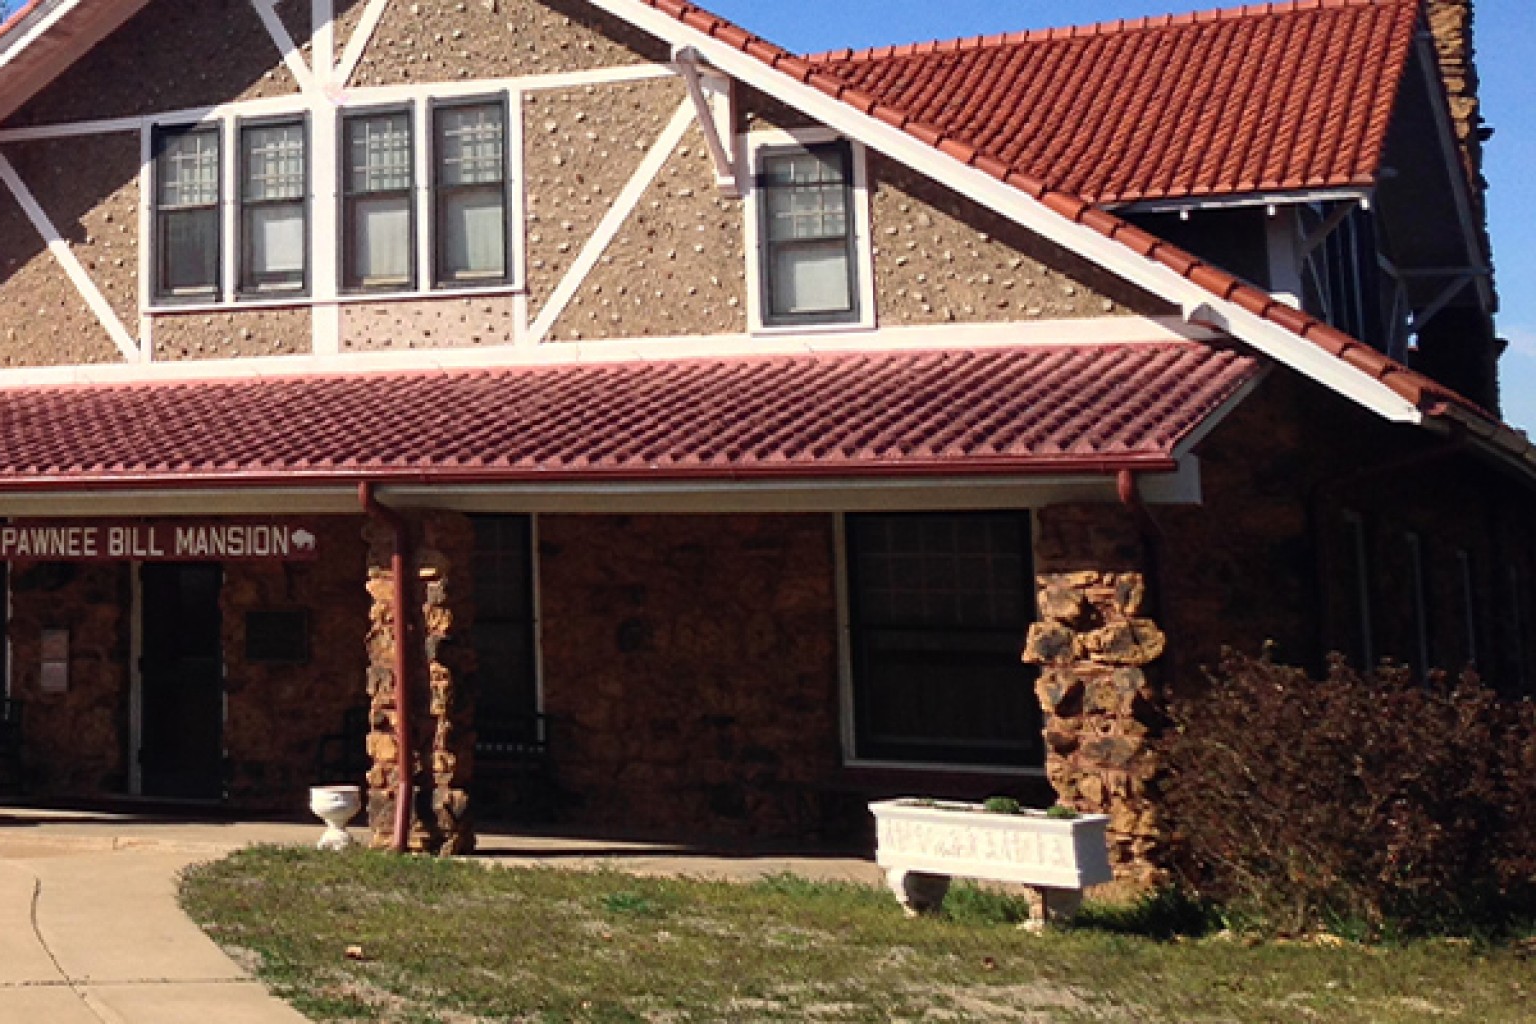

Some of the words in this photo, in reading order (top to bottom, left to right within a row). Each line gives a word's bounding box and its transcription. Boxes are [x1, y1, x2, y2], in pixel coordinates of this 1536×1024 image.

[2, 527, 98, 555] PAWNEE
[109, 527, 164, 556] BILL
[176, 527, 289, 556] MANSION
